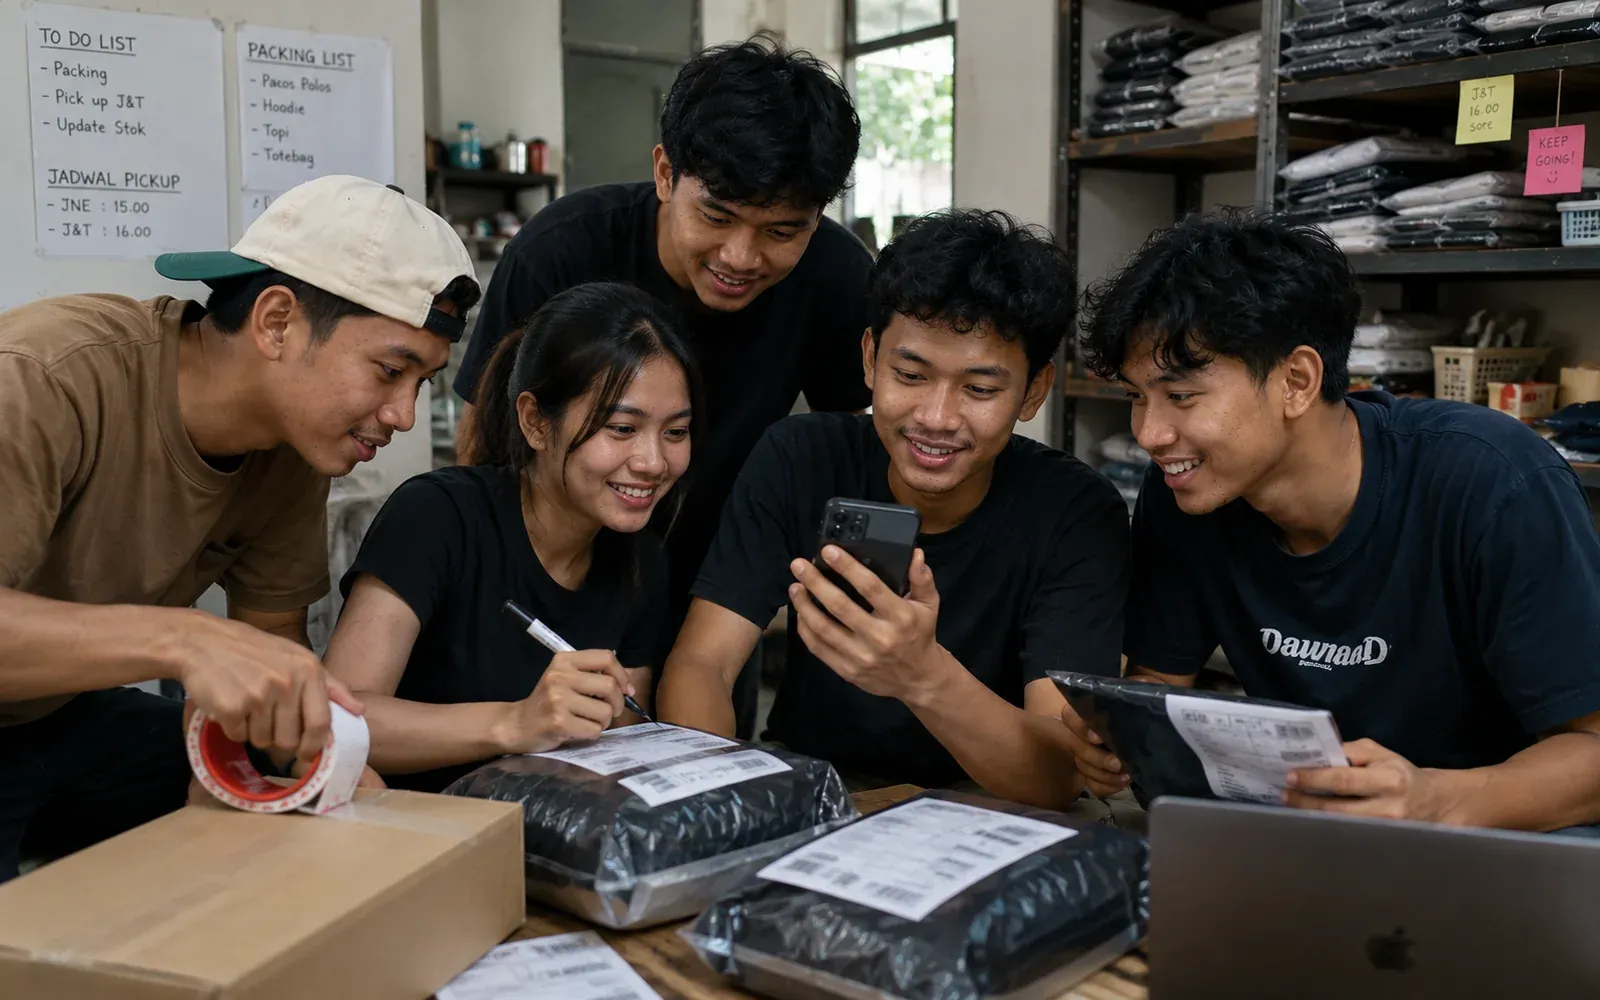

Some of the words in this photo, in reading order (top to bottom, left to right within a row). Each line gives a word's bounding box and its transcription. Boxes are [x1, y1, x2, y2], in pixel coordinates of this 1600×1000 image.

[39, 28, 61, 44] TO
[69, 31, 91, 47] DO
[100, 35, 136, 52] LIST
[248, 42, 316, 64] PACKING
[323, 51, 356, 67] LIST
[54, 61, 107, 85] Packing
[262, 74, 295, 90] Pacos
[301, 77, 331, 93] Polos
[55, 89, 84, 105] Pick
[92, 97, 108, 112] up
[116, 94, 144, 109] J&T
[262, 98, 305, 115] Hoodie
[1469, 103, 1499, 116] 16.00
[57, 117, 106, 136] Update
[114, 120, 147, 136] Stok
[263, 123, 289, 142] Topi
[1539, 135, 1568, 149] KEEP
[264, 148, 315, 169] Totebag
[1535, 151, 1575, 166] GOING!
[47, 168, 116, 187] JADWAL
[124, 172, 181, 189] PICKUP
[61, 198, 91, 213] JNE
[114, 200, 150, 214] 15.00
[62, 223, 92, 237] J&T
[116, 225, 152, 238] 16.00
